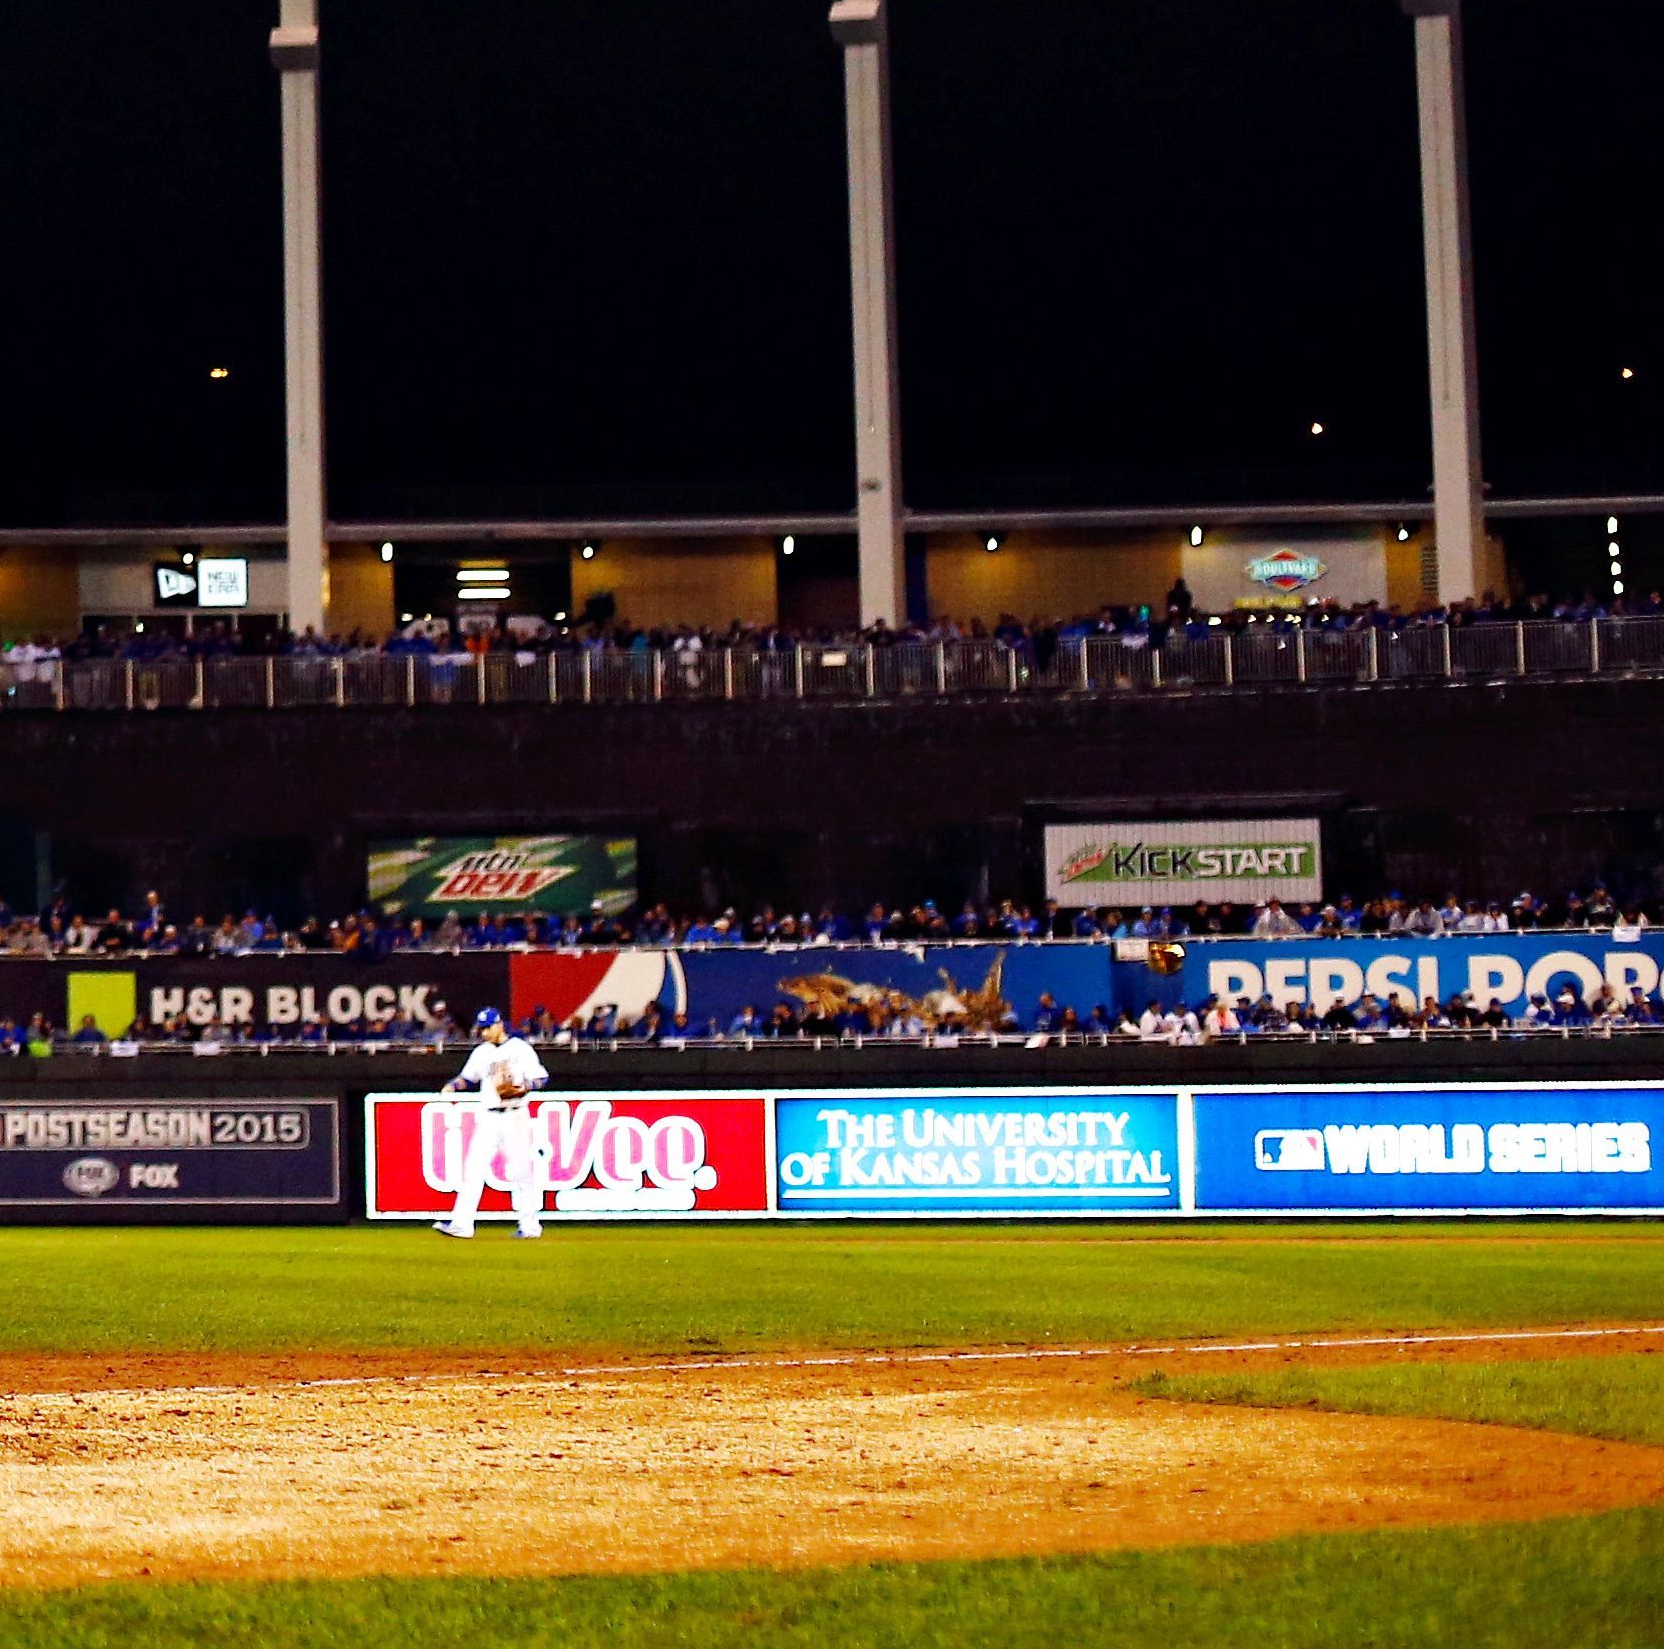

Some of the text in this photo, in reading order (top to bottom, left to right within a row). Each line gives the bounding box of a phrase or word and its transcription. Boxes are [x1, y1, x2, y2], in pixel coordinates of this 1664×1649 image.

[1113, 840, 1307, 878] KICKSTART
[1208, 951, 1664, 1015] PEPSI POR
[151, 985, 432, 1025] H&R BLOCK
[5, 1110, 303, 1148] POSTSEASON 2015
[816, 1108, 1130, 1148] THE UNIVERSITY
[1323, 1121, 1651, 1174] WORLD SERIES
[129, 1163, 179, 1190] FOX
[780, 1147, 1173, 1186] OF KANSAS HOSPITAL
